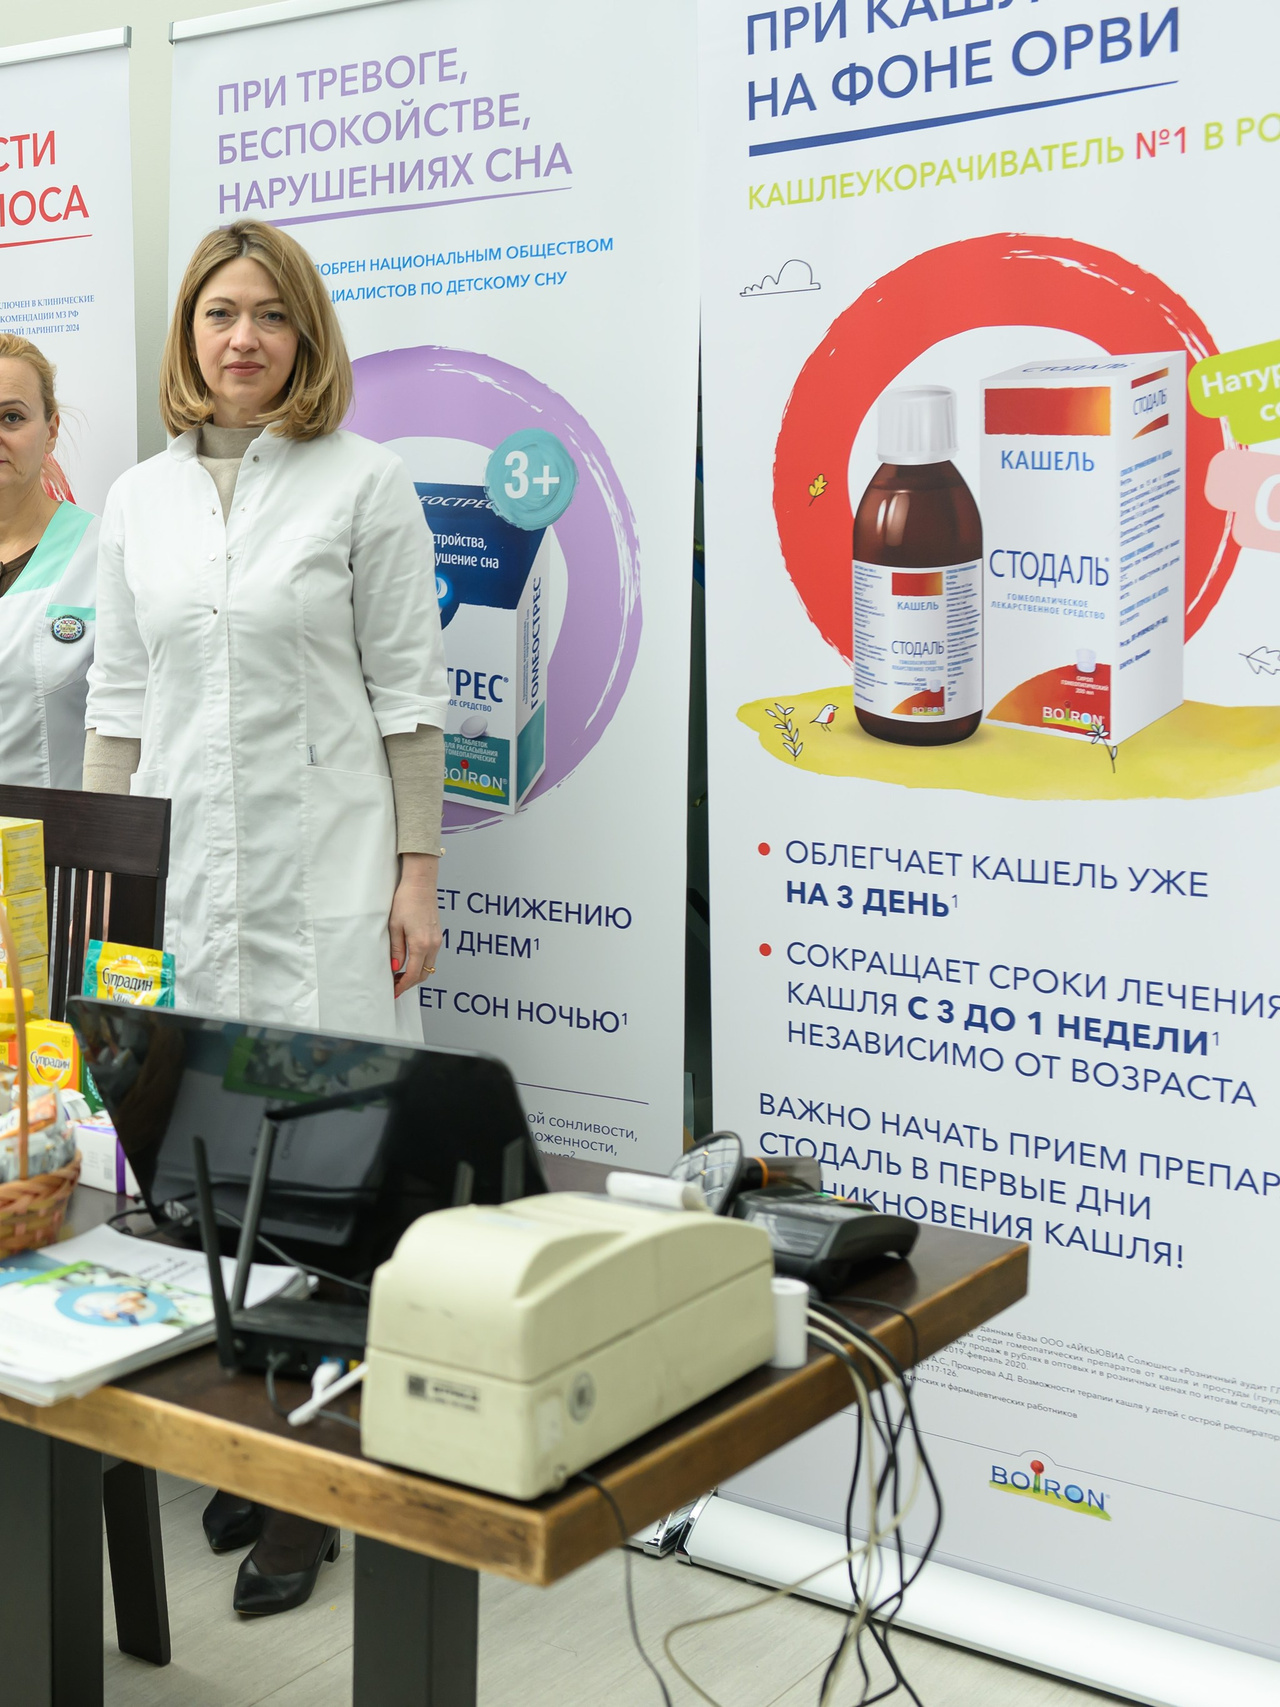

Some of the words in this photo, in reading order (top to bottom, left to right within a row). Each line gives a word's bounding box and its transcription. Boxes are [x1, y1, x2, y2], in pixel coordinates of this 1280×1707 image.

[747, 0, 847, 55] ПРИ
[748, 72, 817, 121] НА
[831, 39, 993, 107] ФОНЕ
[1011, 6, 1180, 77] ОРВИ
[218, 76, 287, 116] ПРИ
[297, 47, 468, 101] ТРЕВОГЕ,
[218, 92, 531, 165] БЕСПОКОЙСТВЕ,
[218, 152, 474, 214] НАРУШЕНИЯХ
[485, 142, 572, 182] СНА
[748, 136, 1124, 210] КАШЛЕУКОРАЧИВАТЕЛЬ
[1135, 126, 1188, 159] №1
[1204, 121, 1224, 151] В
[370, 247, 501, 271] НАЦИОНАЛЬНЫМ
[506, 237, 614, 259] ОБЩЕСТВОМ
[420, 280, 443, 296] ПО
[447, 274, 529, 296] ДЕТСКОМУ
[535, 271, 568, 286] СНУ
[37, 295, 95, 307] КЛИНИЧЕСКИЕ
[55, 311, 66, 319] МЗ
[68, 309, 79, 318] РФ
[25, 325, 64, 336] ЛАРИНГИТ
[65, 323, 80, 332] 2024
[504, 450, 560, 499] 3+
[1001, 449, 1095, 472] КАШЕЛЬ
[480, 556, 499, 569] сна
[897, 601, 939, 611] КАШЕЛЬ
[991, 600, 1060, 616] ЛЕКАРСТВЕННОЕ
[1063, 605, 1106, 620] СРЕДСТВО
[1007, 593, 1088, 608] ГОМЕОПАТИЧЕСКОЕ
[531, 577, 541, 710] ГОМЕОСТРЕС
[459, 700, 492, 712] СРЕДСТВО
[445, 748, 496, 763] ГОМЕОПАТИЧЕСКИХ
[457, 744, 498, 757] РАССАСЫВАНИЯ
[462, 737, 488, 748] ТАБЛЕТОК
[785, 839, 962, 877] ОБЛЕГЧАЕТ
[972, 855, 1118, 890] КАШЕЛЬ
[1128, 866, 1209, 898] УЖЕ
[467, 892, 632, 930] СНИЖЕНИЮ
[786, 880, 828, 907] НА
[837, 885, 853, 908] 3
[102, 967, 153, 992] Супрадин
[786, 941, 980, 985] СОКРАЩАЕТ
[988, 963, 1107, 1001] СРОКИ
[453, 992, 509, 1019] СОН
[787, 981, 898, 1017] КАШЛЯ
[908, 996, 929, 1021] С
[937, 999, 955, 1025] 3
[964, 1003, 1016, 1034] ДО
[1027, 1011, 1042, 1035] 1
[30, 1051, 70, 1070] Супрадин
[787, 1020, 1004, 1073] НЕЗАВИСИМО
[1014, 1051, 1061, 1079] ОТ
[1072, 1058, 1257, 1108] ВОЗРАСТА
[548, 1116, 638, 1142] сонливости,
[759, 1092, 871, 1131] ВАЖНО
[881, 1111, 999, 1153] НАЧАТЬ
[1009, 1132, 1125, 1174] ПРИЕМ
[759, 1131, 902, 1177] СТОДАЛЬ
[912, 1156, 928, 1180] В
[939, 1162, 1066, 1204] ПЕРВЫЕ
[1076, 1185, 1152, 1220] ДНИ
[820, 1181, 1032, 1241] НИКНОВЕНИЯ
[1044, 1221, 1184, 1269] КАШЛЯ!
[980, 1326, 1014, 1338] данным
[1016, 1331, 1038, 1343] базы
[1040, 1337, 1064, 1348] ООО
[969, 1342, 1002, 1355] продаж
[1010, 1351, 1042, 1364] рублях
[1051, 1360, 1089, 1374] оптовых
[1107, 1372, 1156, 1388] розничных
[1159, 1383, 1187, 1396] ценах
[1204, 1394, 1238, 1406] итогам
[977, 1334, 1003, 1345] среди
[1006, 1340, 1084, 1362] гомеопатических
[1087, 1357, 1141, 1375] препаратов
[1159, 1373, 1189, 1385] кашля
[1203, 1383, 1250, 1398] простуды
[947, 1383, 1025, 1407] фармацевтических
[1027, 1402, 1078, 1418] работников
[951, 1360, 996, 1377] Прохорова
[1017, 1376, 1075, 1394] Возможности
[1078, 1389, 1113, 1402] терапии
[1116, 1397, 1143, 1410] кашля
[1152, 1407, 1179, 1418] детей
[1188, 1415, 1222, 1428] острой
